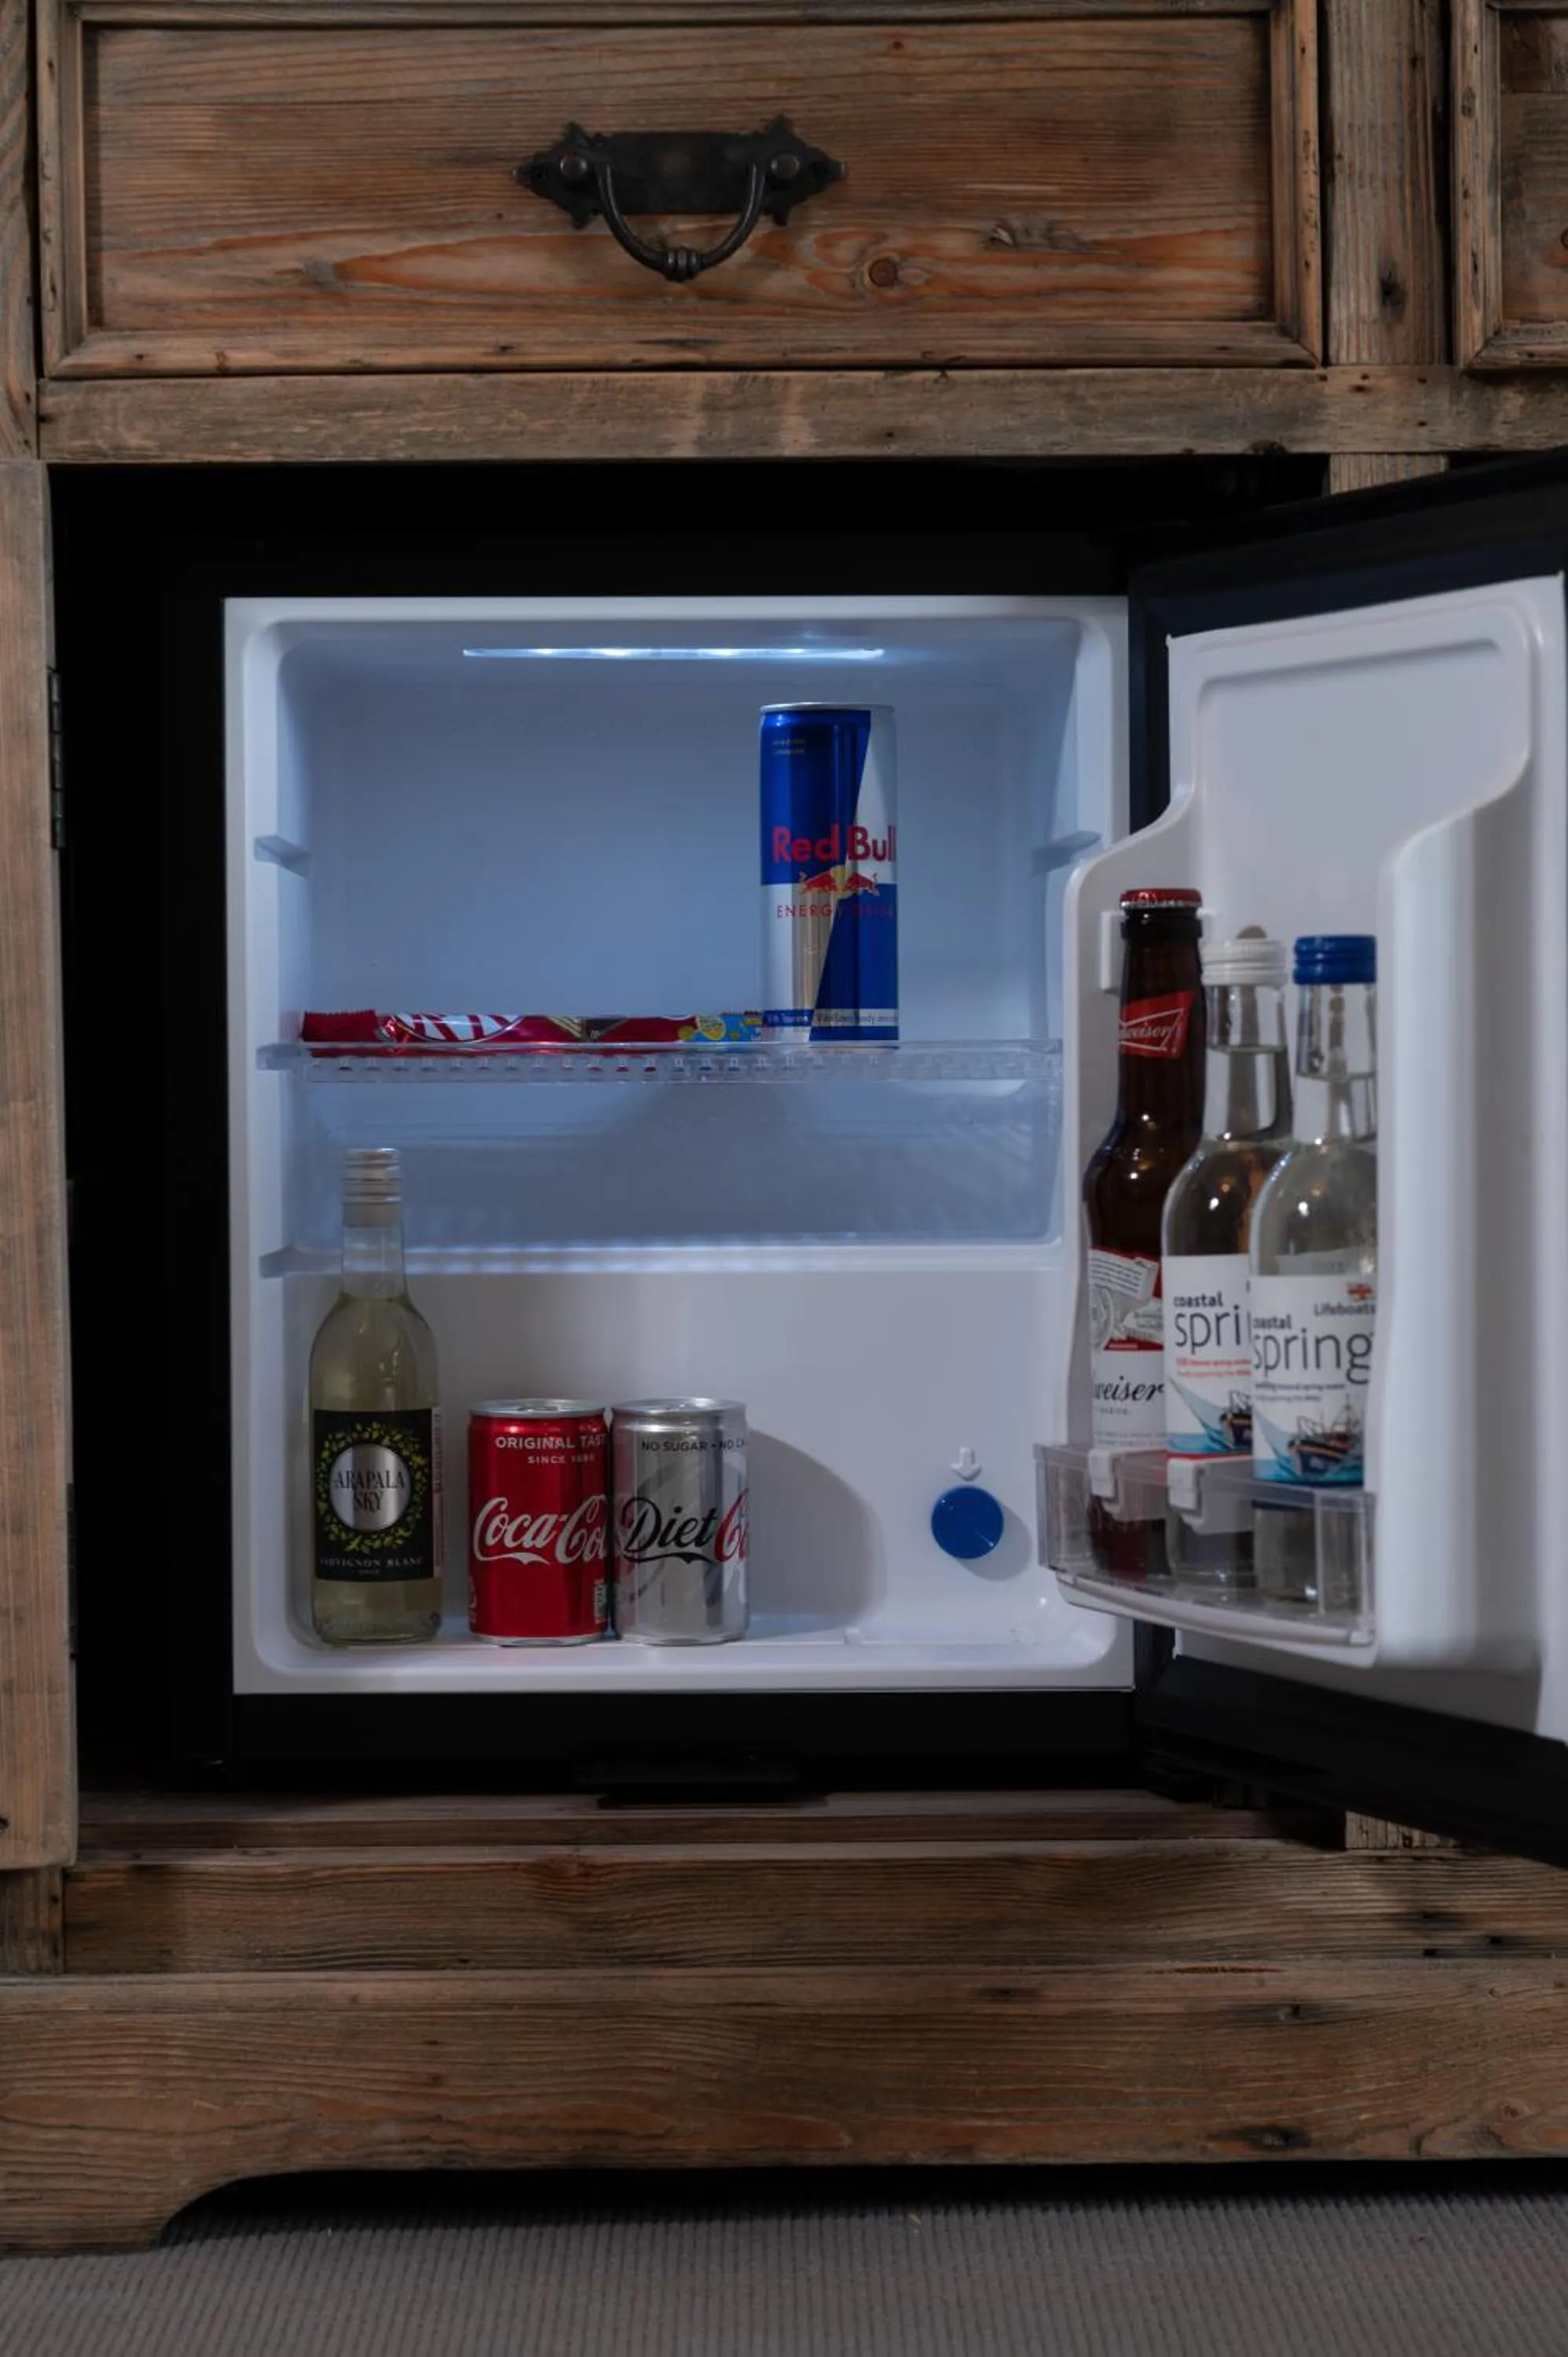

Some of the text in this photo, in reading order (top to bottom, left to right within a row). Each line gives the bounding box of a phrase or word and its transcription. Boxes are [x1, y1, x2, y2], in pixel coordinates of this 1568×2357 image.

[772, 822, 841, 863] Red
[1173, 1290, 1224, 1307] coastal
[1174, 1303, 1251, 1355] spri
[495, 1435, 576, 1450] ORIGINAL
[641, 1441, 660, 1452] NO
[663, 1440, 708, 1452] SUGAR
[527, 1454, 566, 1464] SINCE
[354, 1490, 385, 1514] SKY
[621, 1496, 718, 1563] Diet
